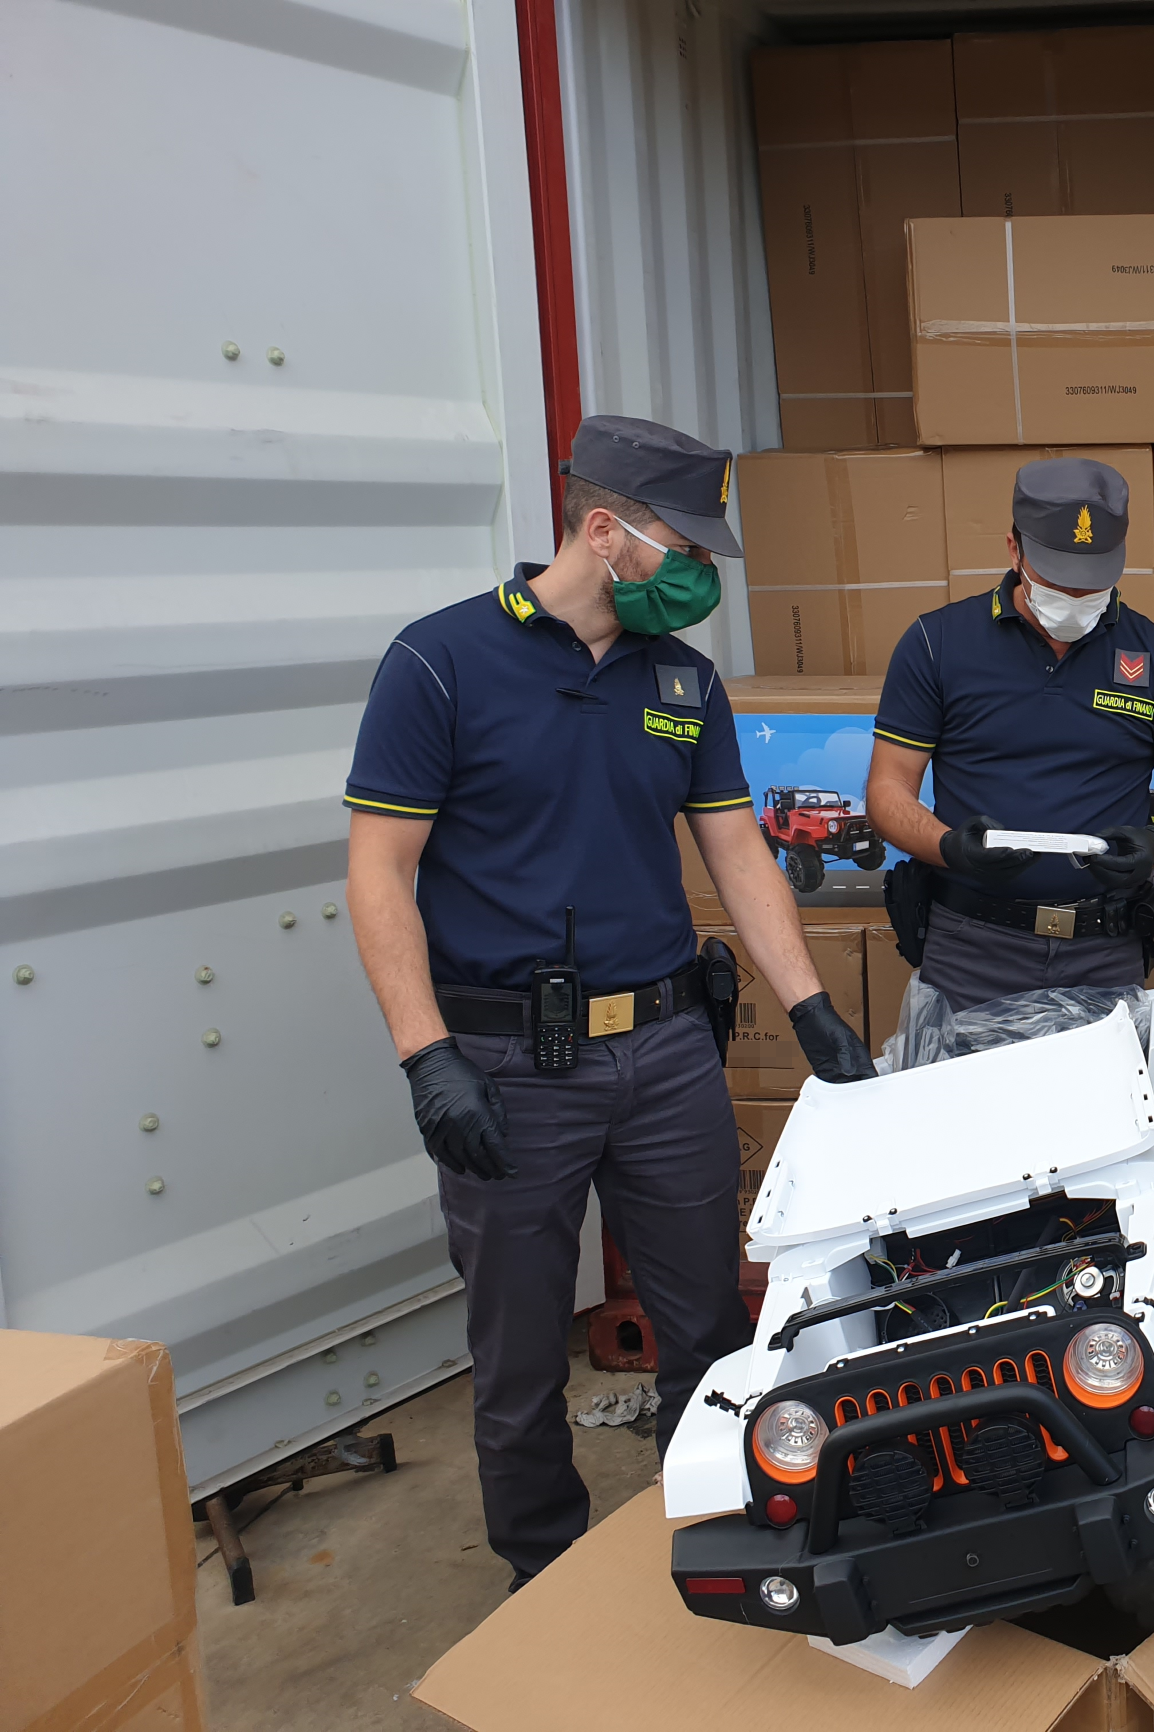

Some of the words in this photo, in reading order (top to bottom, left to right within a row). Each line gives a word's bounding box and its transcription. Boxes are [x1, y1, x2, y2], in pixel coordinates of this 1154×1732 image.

[1065, 385, 1137, 396] 3307609311/WJ3049
[791, 605, 804, 673] 3307609311/WJ3049
[1096, 694, 1125, 709] GUARDIA
[1125, 701, 1132, 711] di
[646, 715, 675, 734] GUARDIA
[675, 724, 683, 735] di
